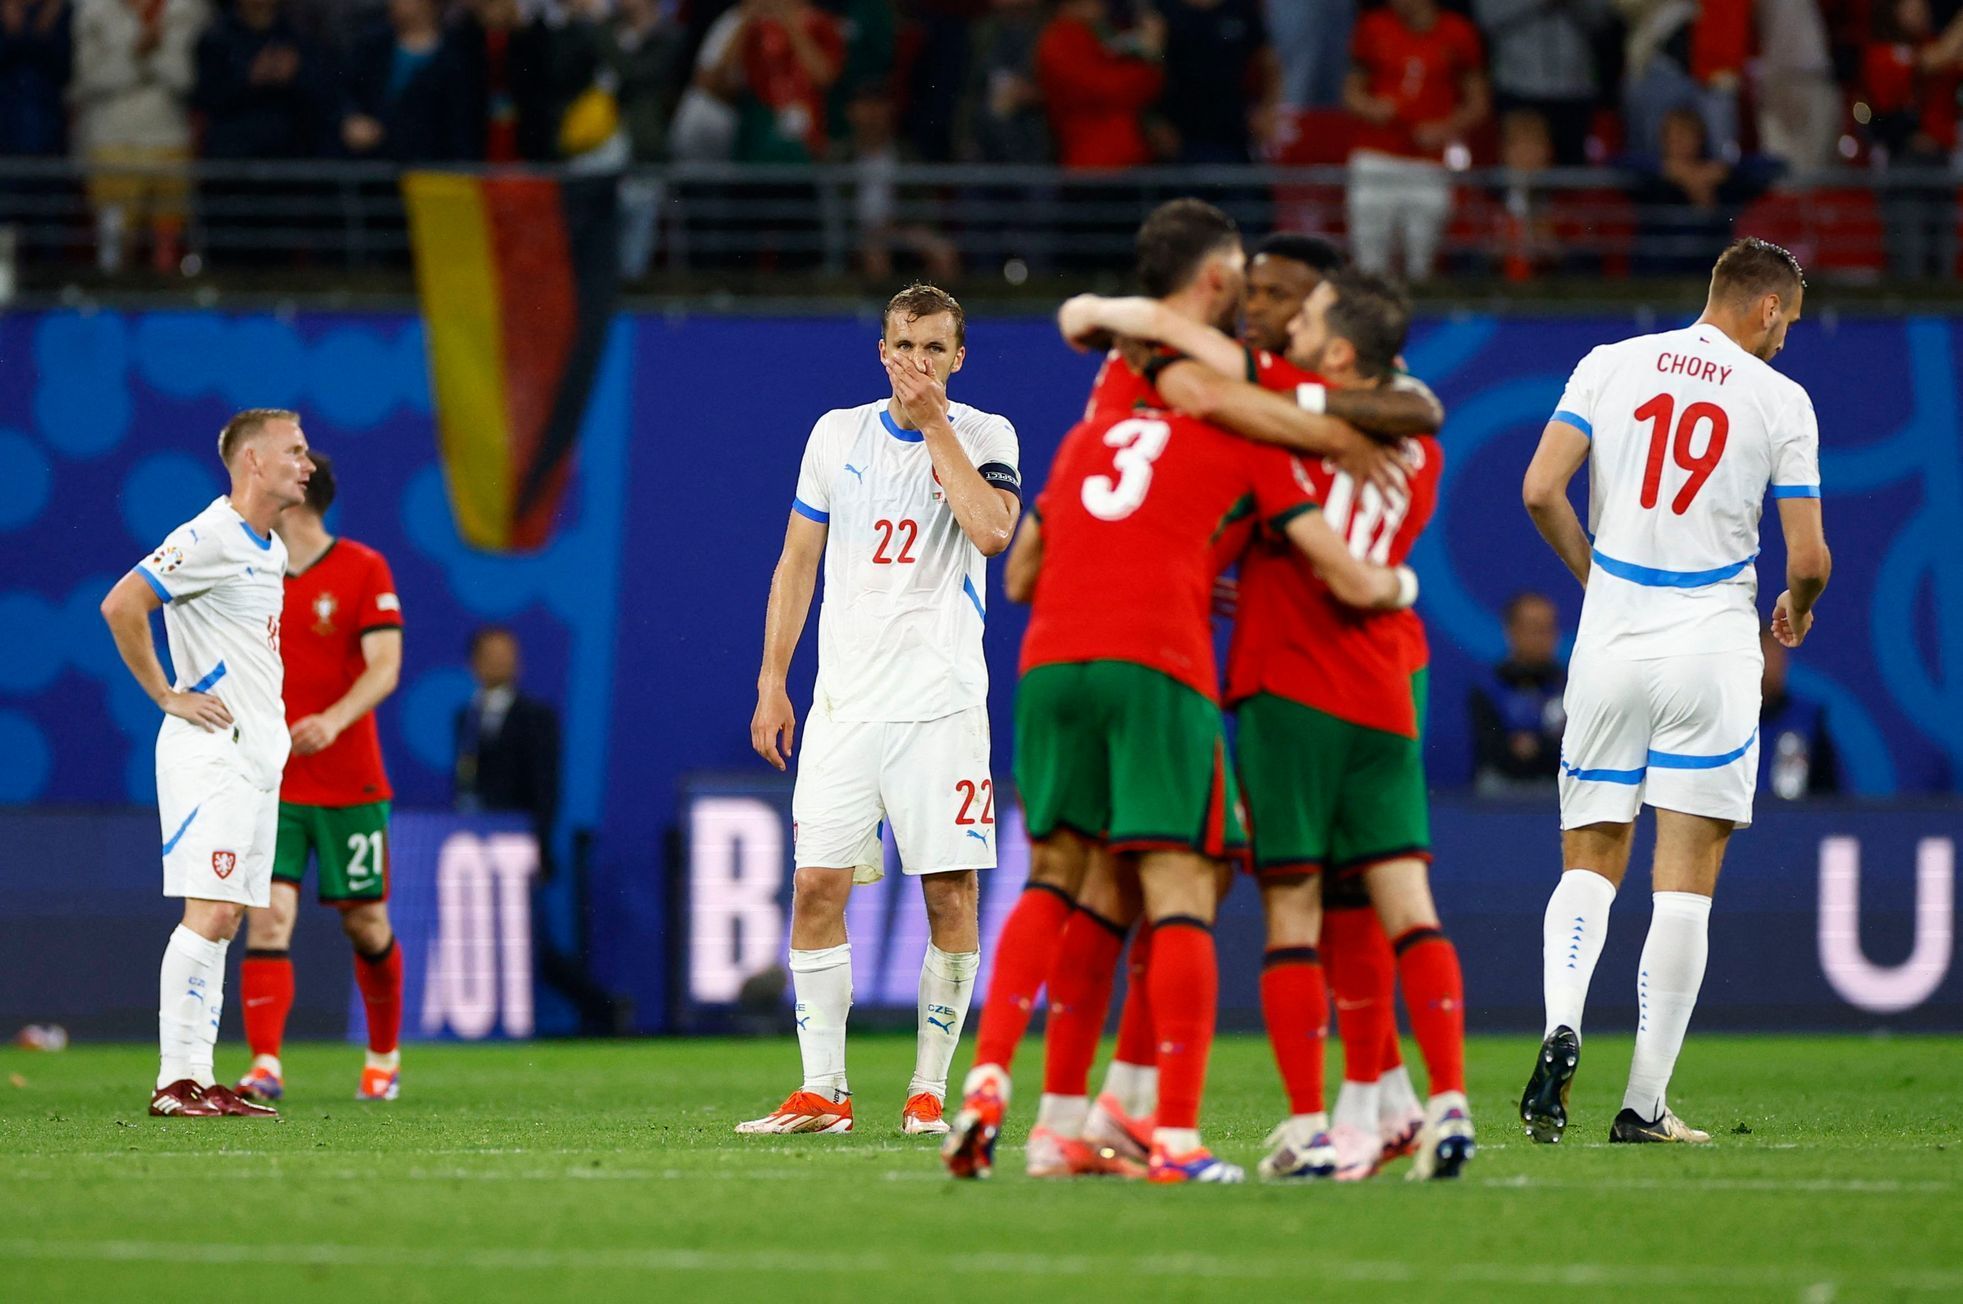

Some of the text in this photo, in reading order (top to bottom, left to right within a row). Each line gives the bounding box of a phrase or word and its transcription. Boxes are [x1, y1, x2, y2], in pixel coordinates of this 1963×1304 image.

[1656, 351, 1732, 386] CHORÝ
[1081, 417, 1172, 521] 3
[1633, 392, 1730, 516] 19
[872, 518, 918, 564] 22
[955, 779, 994, 825] 22
[347, 830, 384, 876] 21
[1817, 836, 1955, 1013] U
[927, 1003, 954, 1015] CZE
